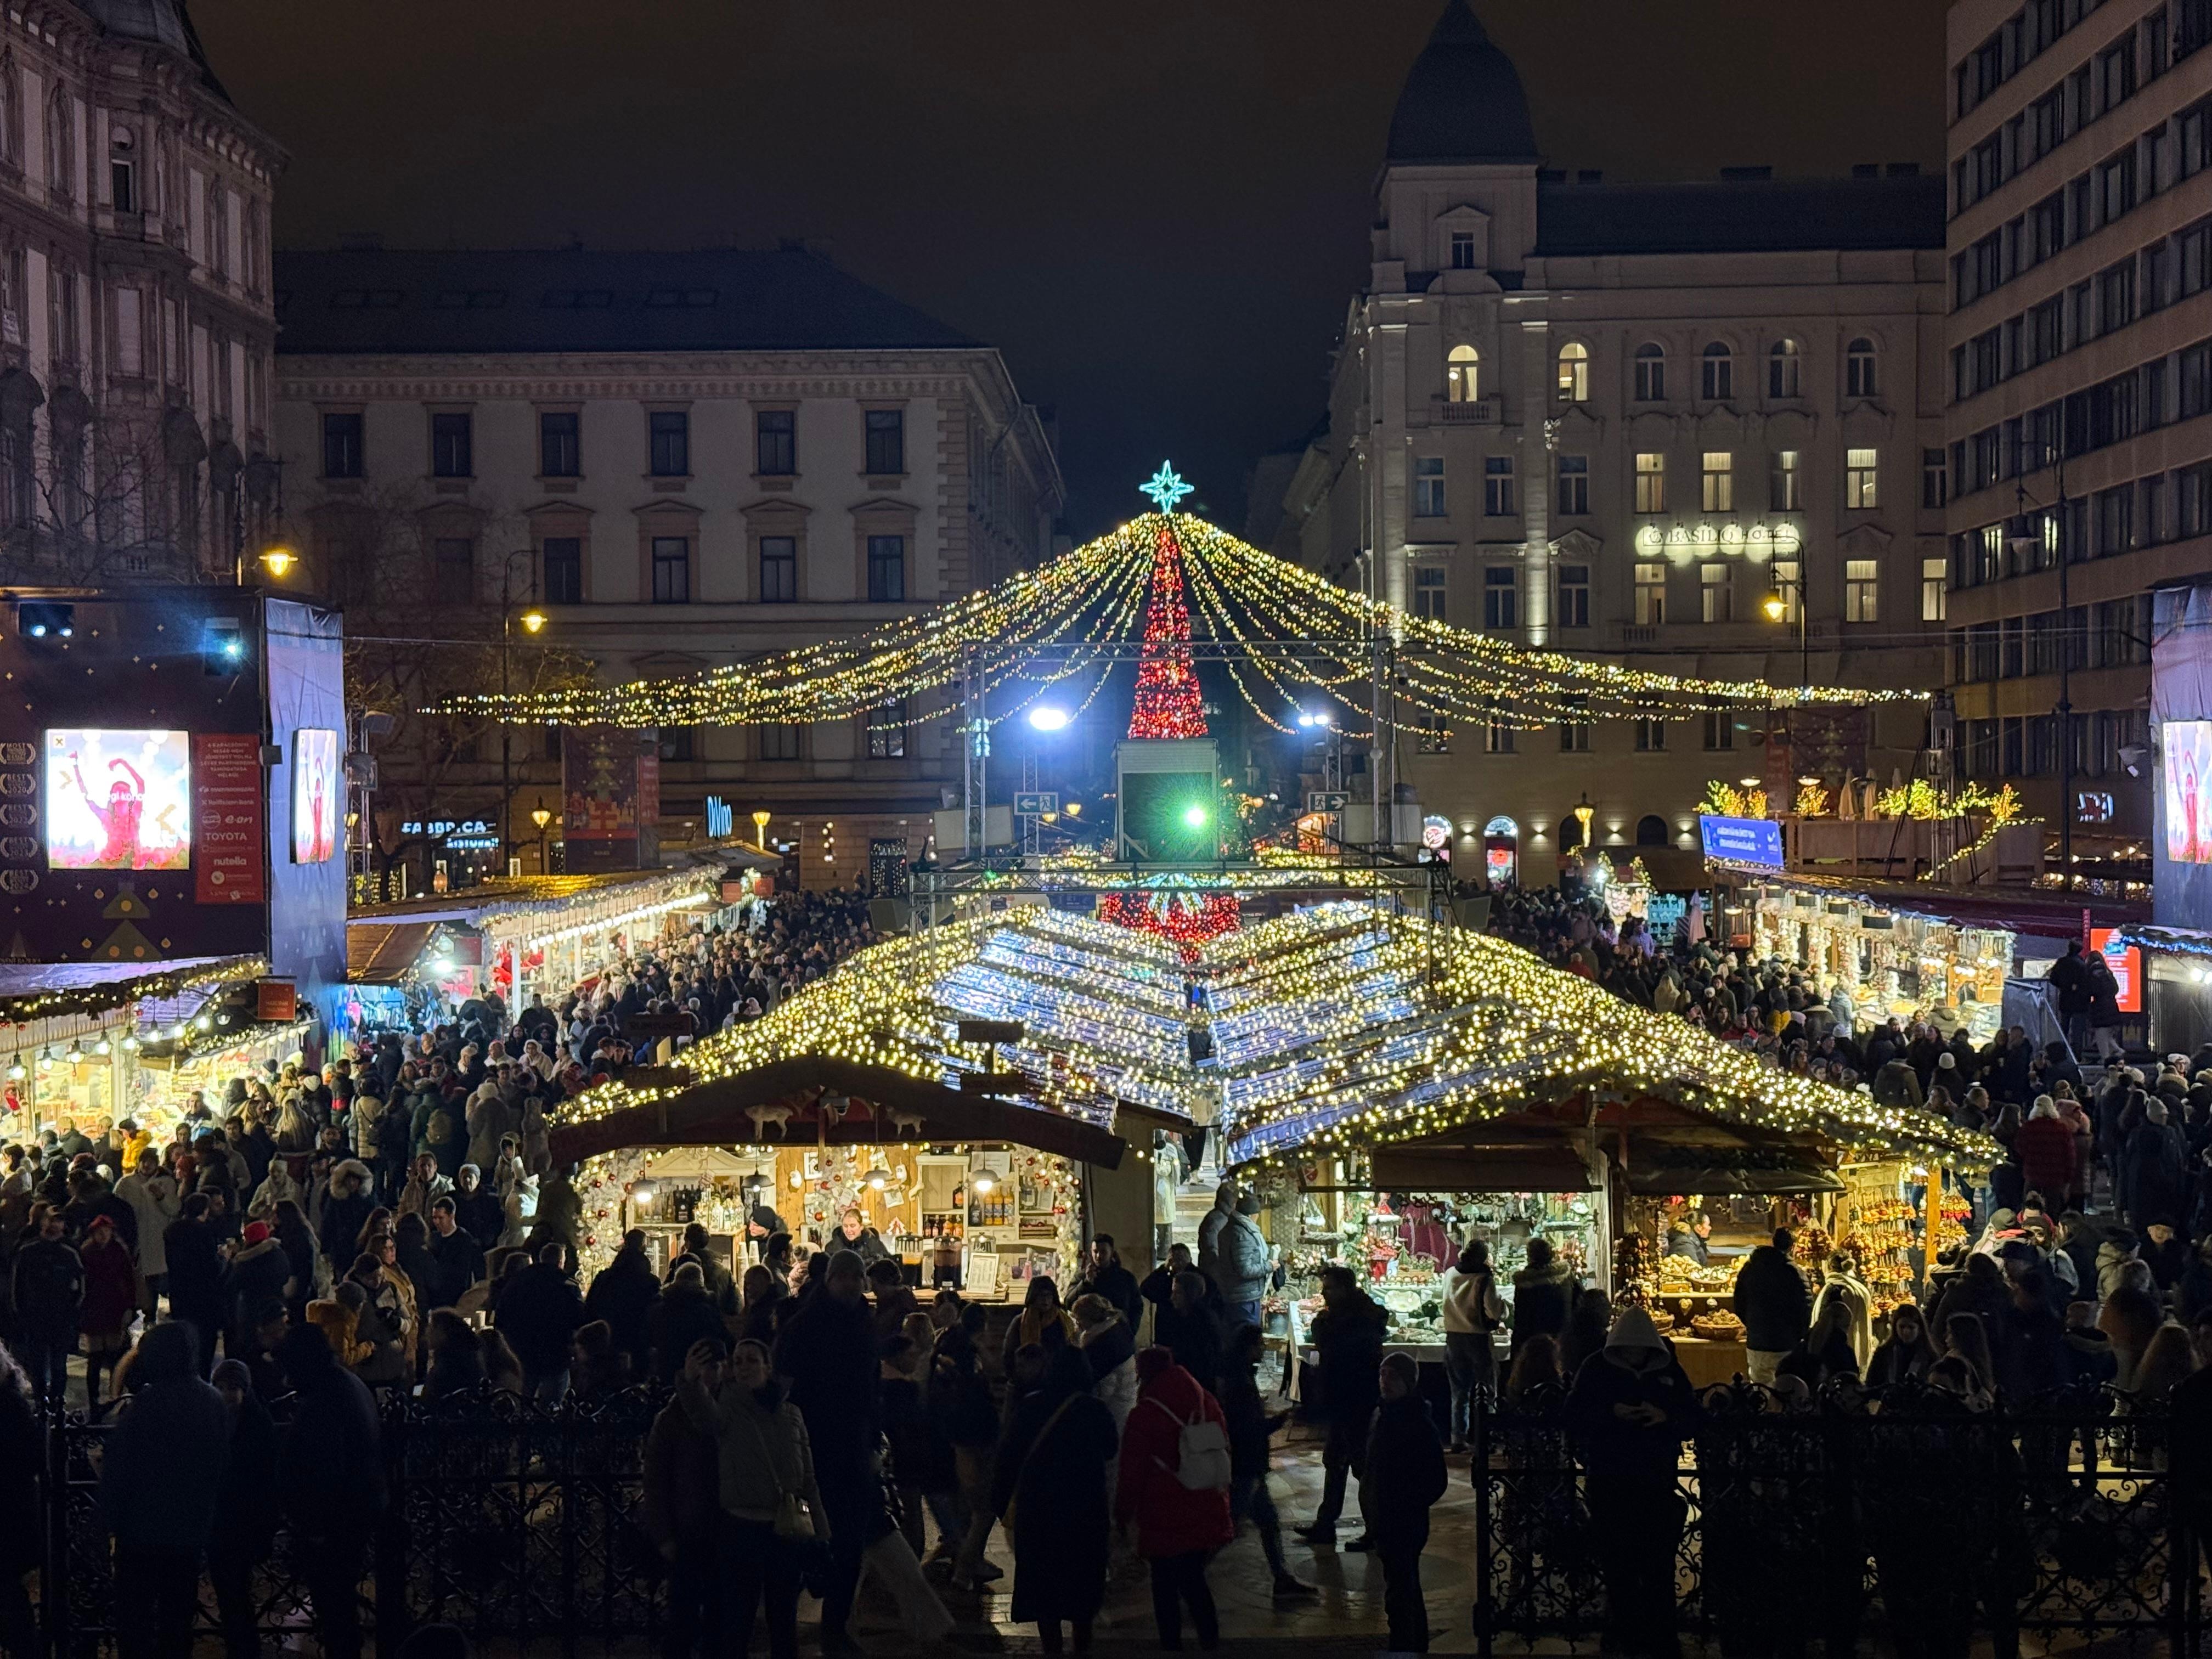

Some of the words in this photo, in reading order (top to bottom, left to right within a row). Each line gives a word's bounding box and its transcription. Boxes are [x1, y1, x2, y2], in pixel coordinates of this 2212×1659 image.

[1668, 529, 1734, 544] BASILIQ
[708, 795, 732, 838] DiVino
[206, 832, 247, 840] TOYOTA
[214, 856, 246, 865] nutella
